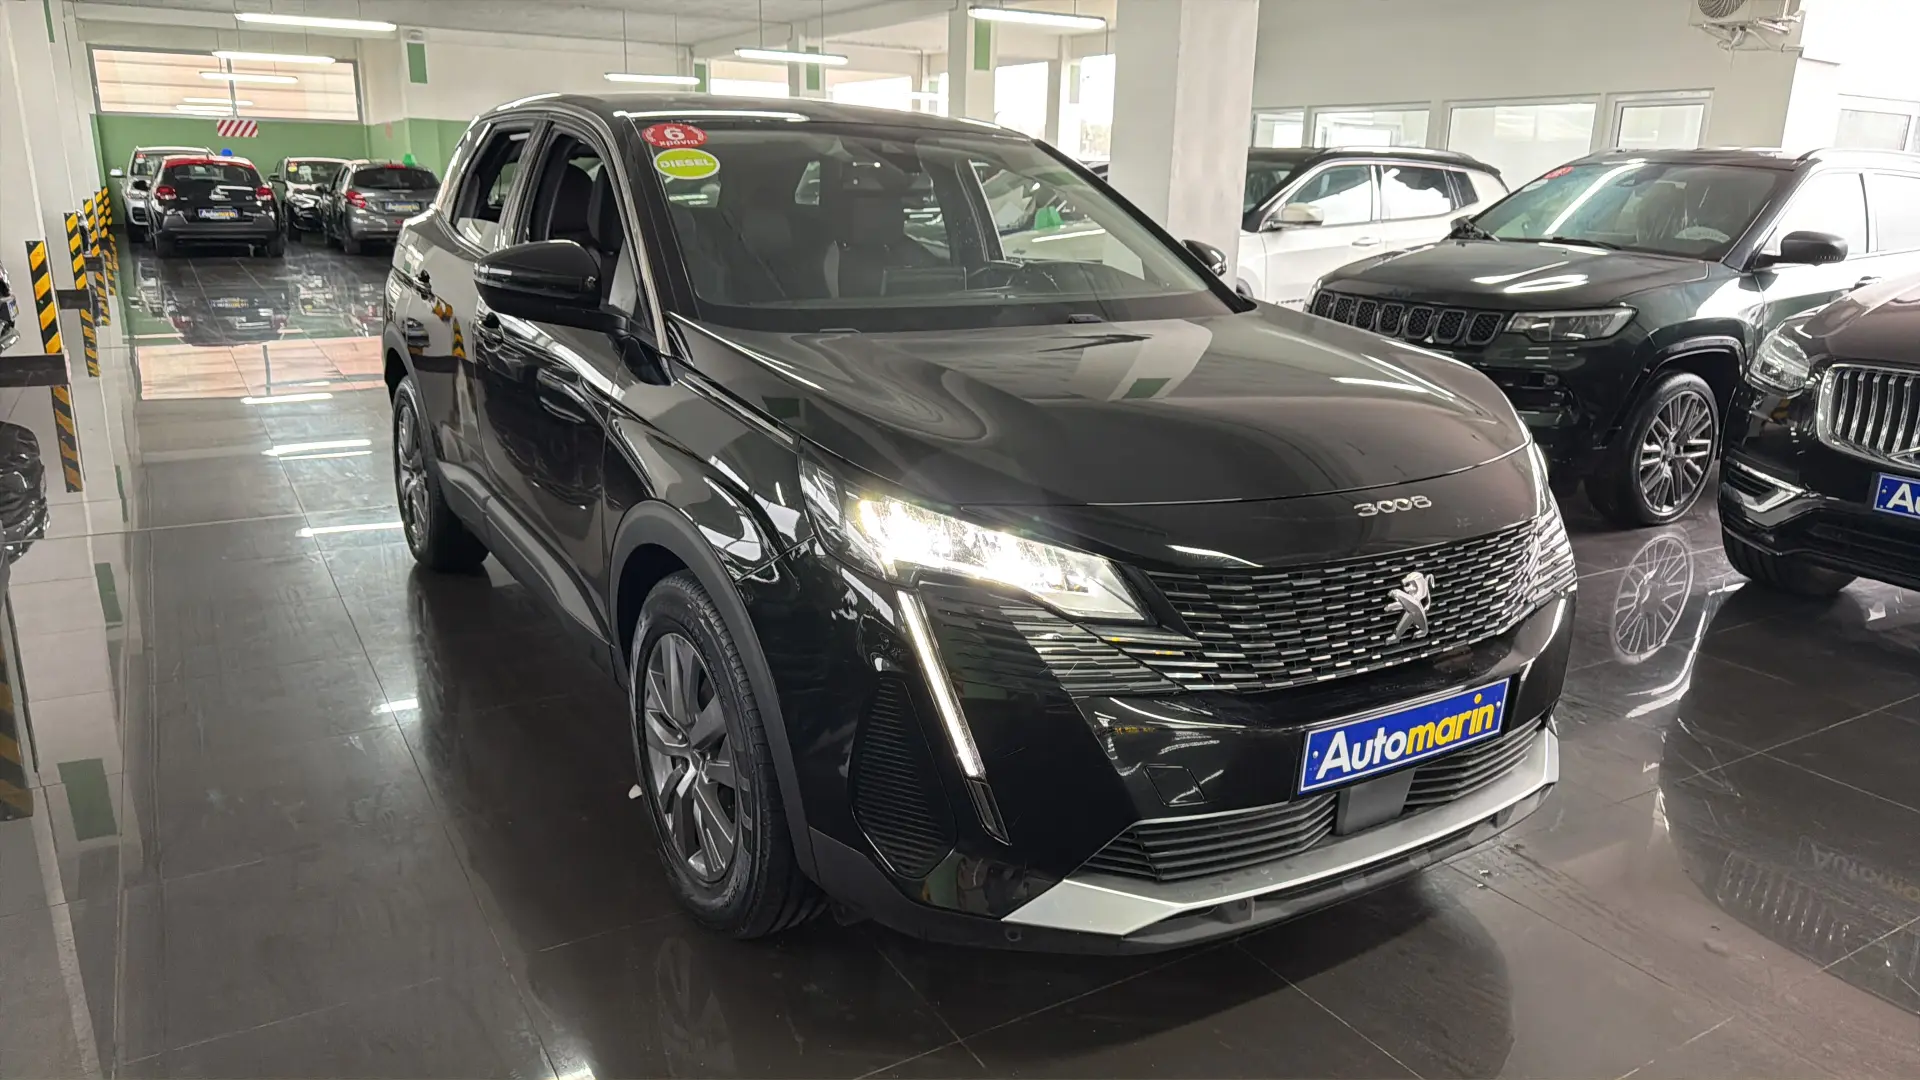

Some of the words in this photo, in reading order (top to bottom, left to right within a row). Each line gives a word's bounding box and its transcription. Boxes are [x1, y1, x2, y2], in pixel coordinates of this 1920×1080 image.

[664, 127, 685, 140] 6
[660, 158, 714, 168] DIESEL
[1353, 495, 1432, 517] 3008
[1315, 693, 1495, 780] Automarin
